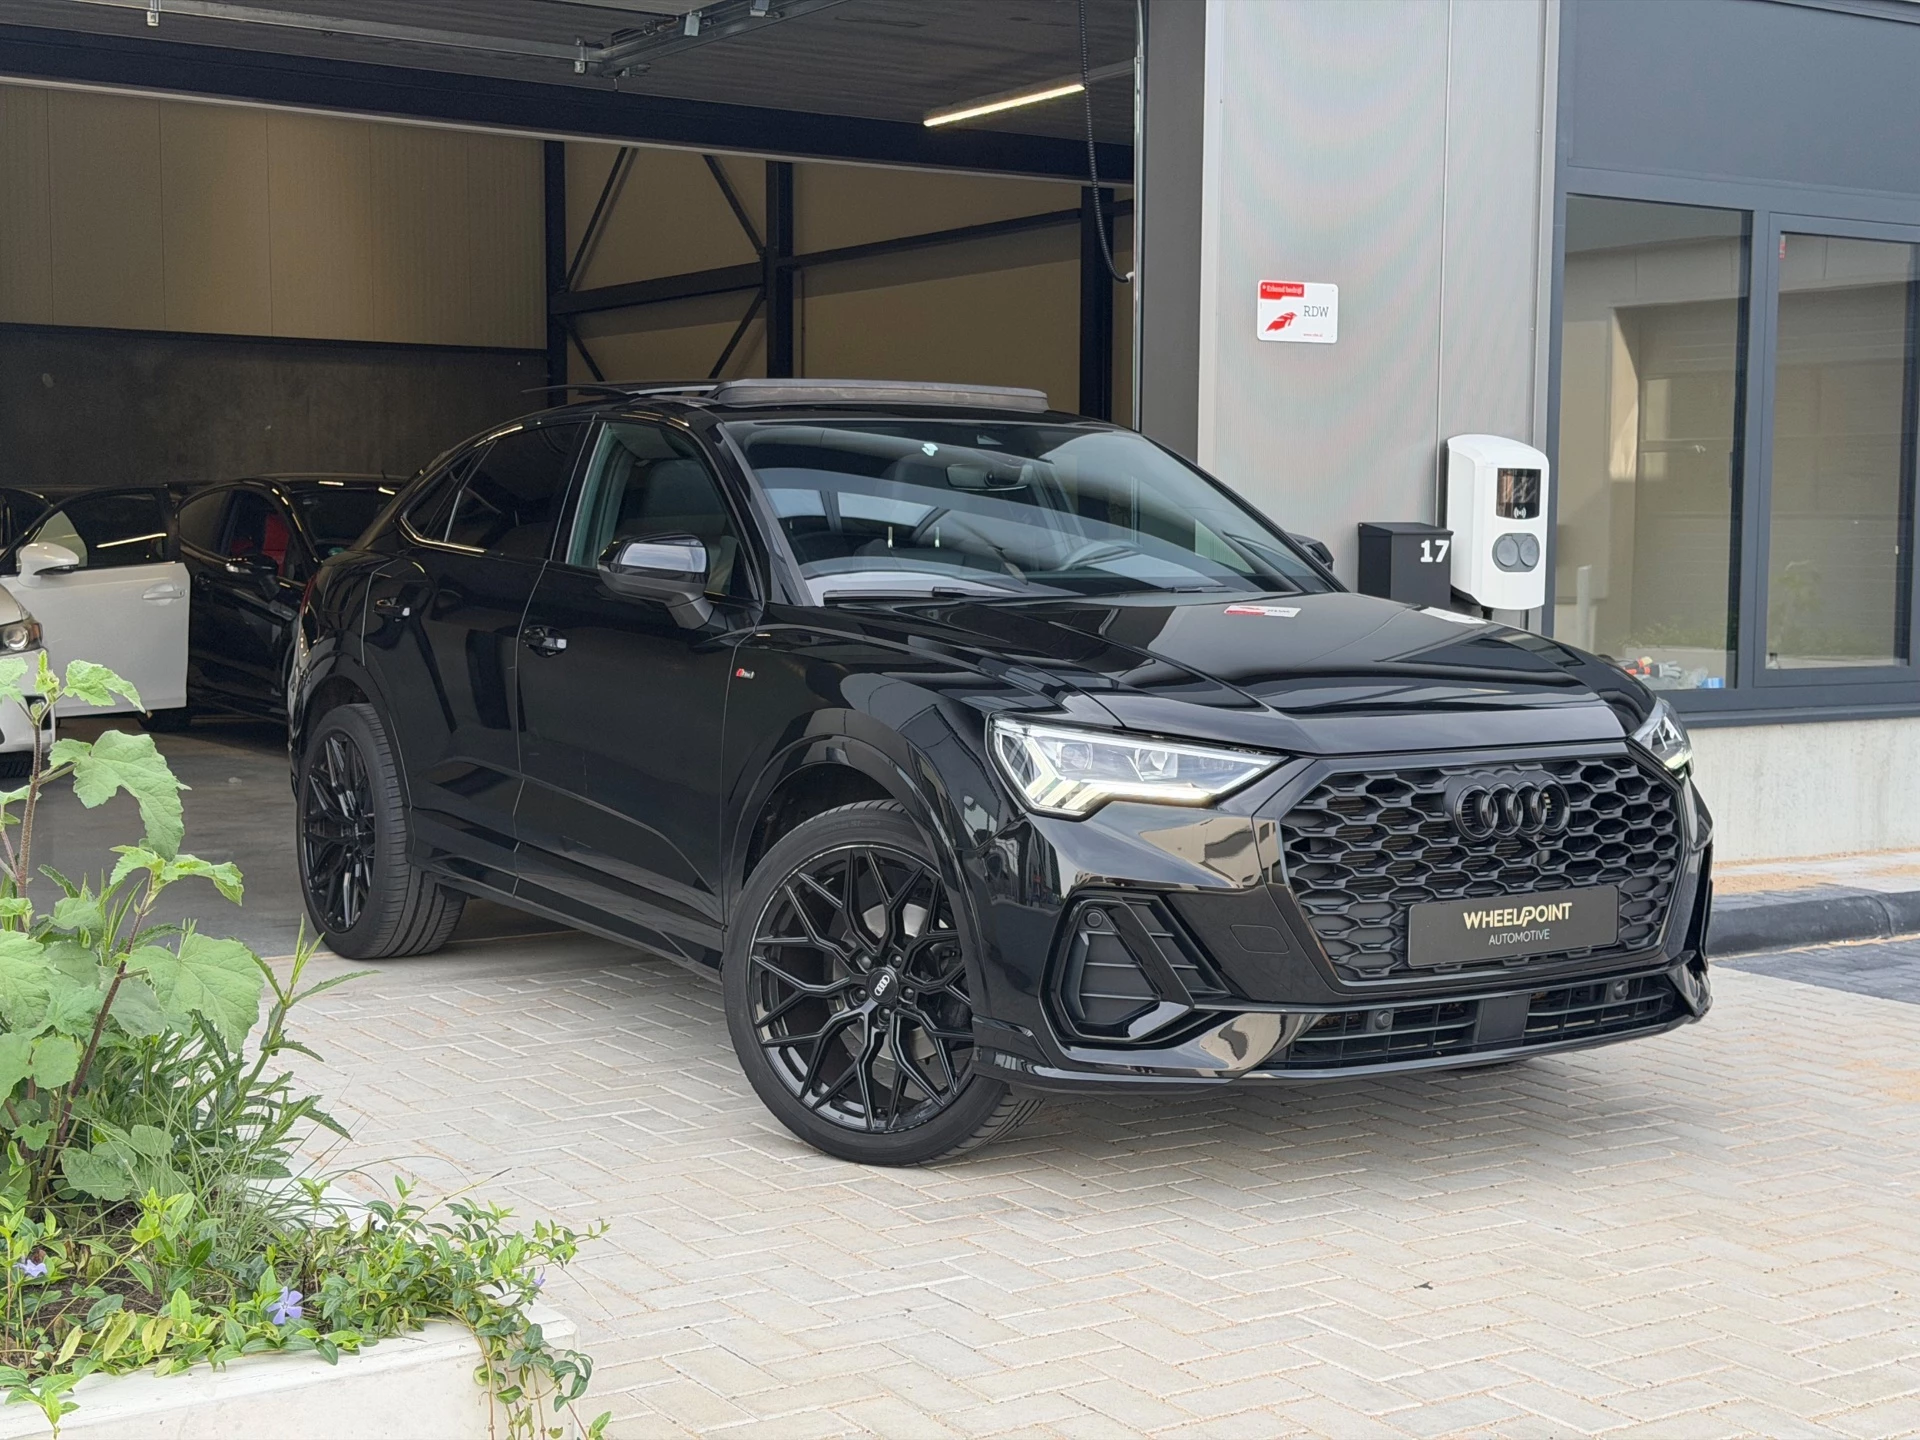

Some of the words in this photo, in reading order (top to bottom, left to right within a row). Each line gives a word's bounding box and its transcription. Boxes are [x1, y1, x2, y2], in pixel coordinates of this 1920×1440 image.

[1303, 305, 1329, 318] RDW
[1420, 539, 1450, 563] 17
[1463, 902, 1573, 930] WHEELPOINT
[1488, 928, 1551, 946] AUTOMOTIVE
